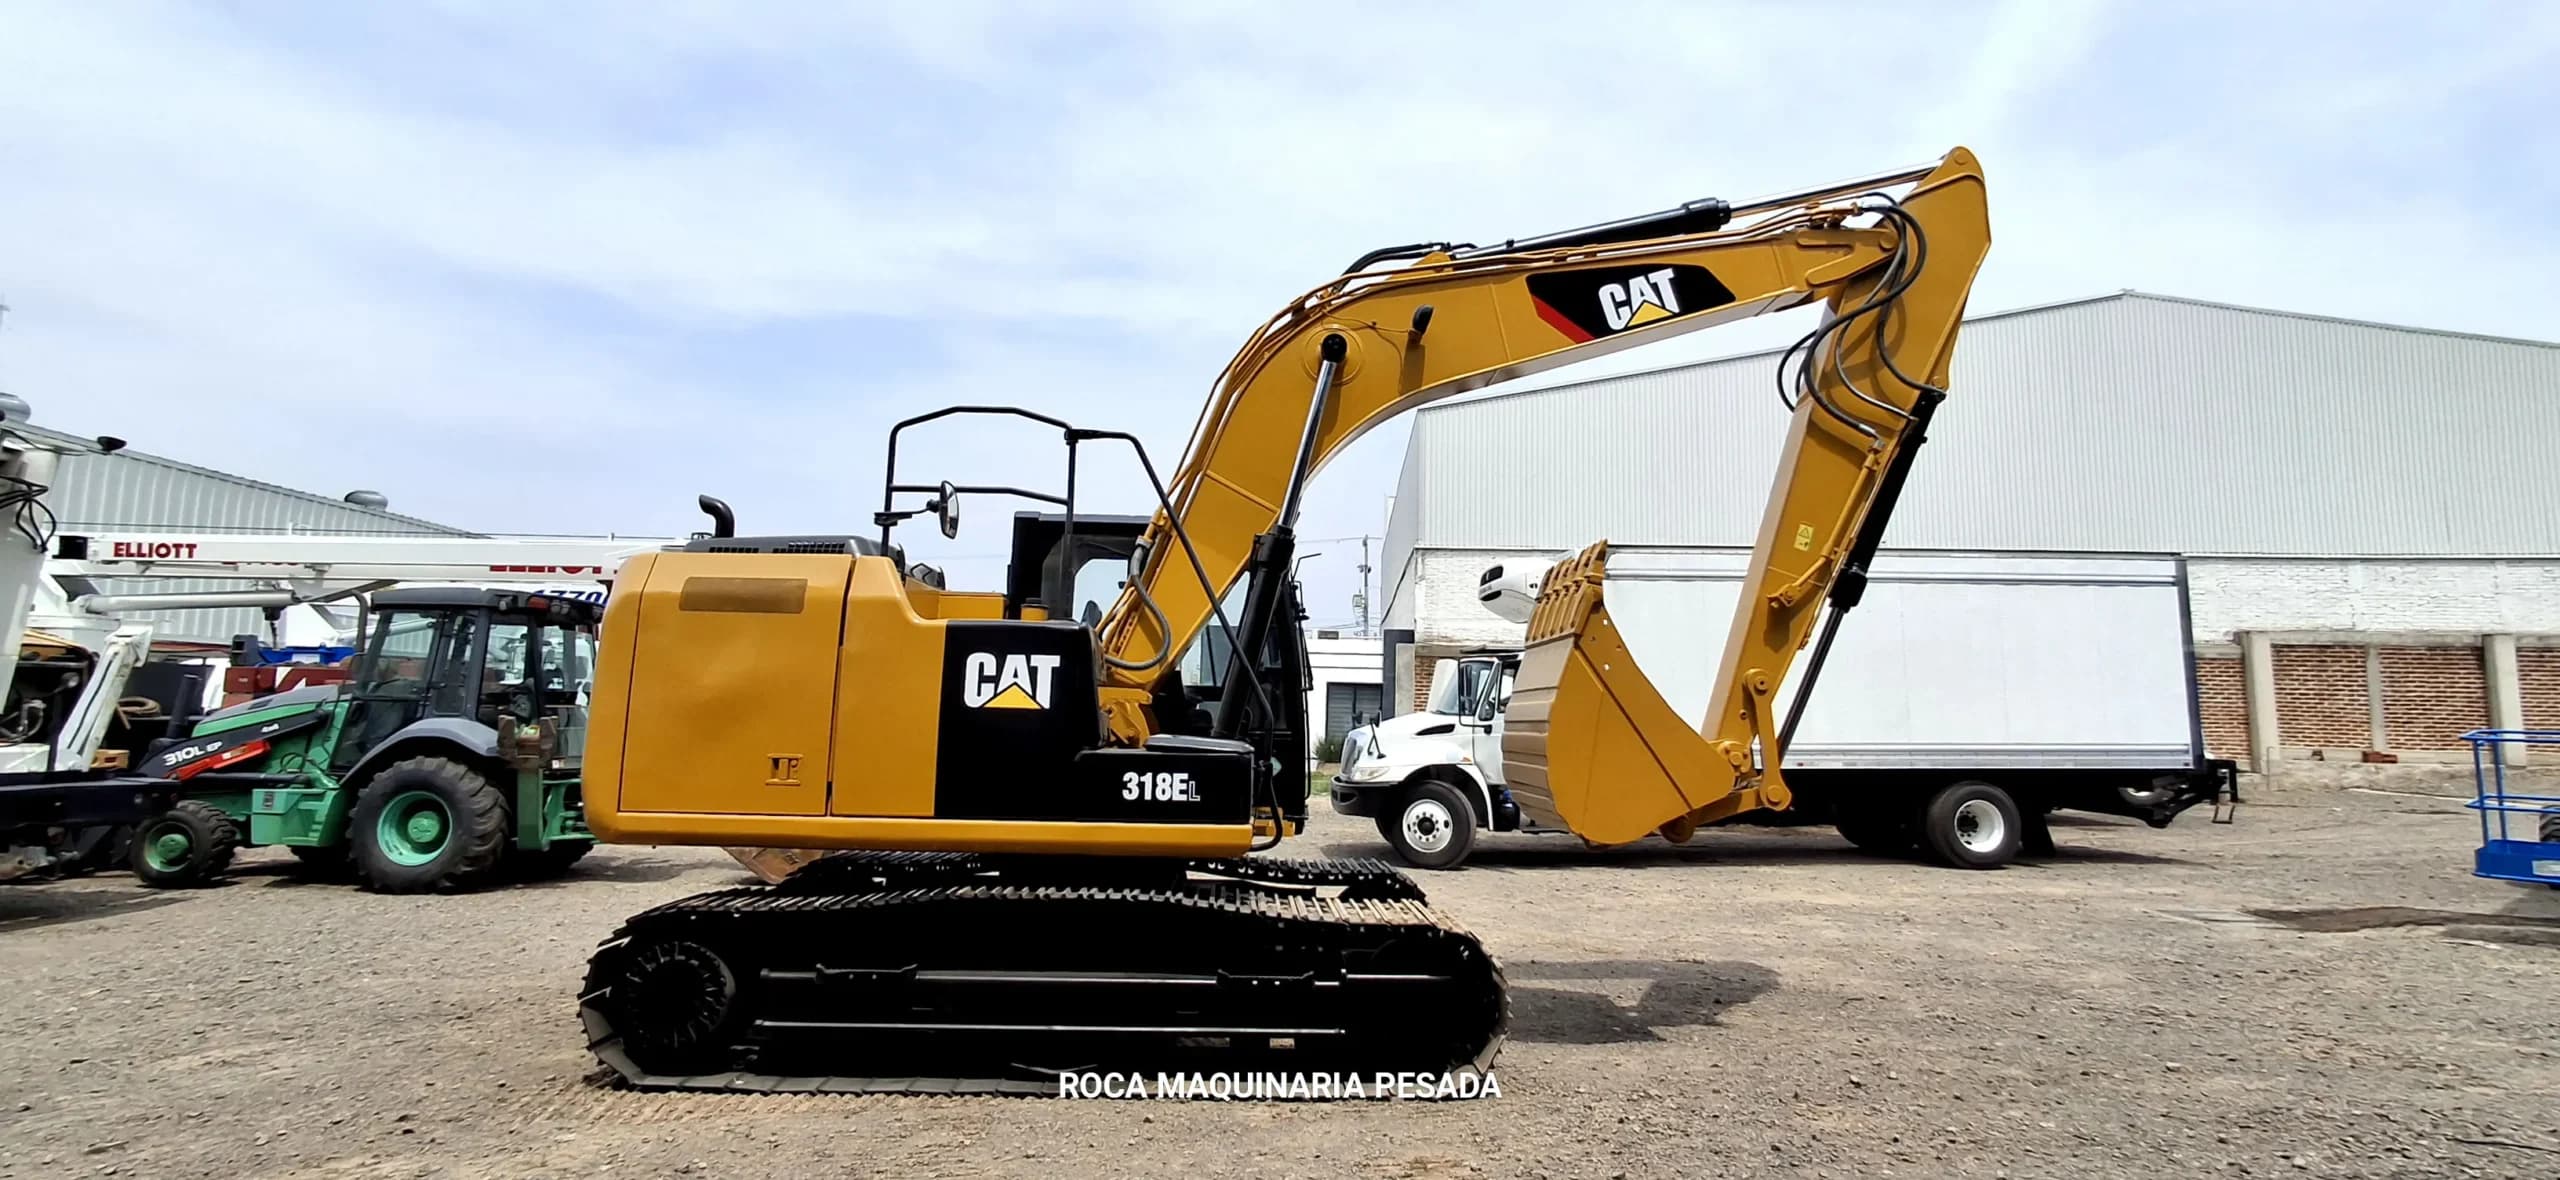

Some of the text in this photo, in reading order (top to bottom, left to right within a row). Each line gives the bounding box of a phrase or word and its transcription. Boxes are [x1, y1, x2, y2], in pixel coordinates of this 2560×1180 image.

[1598, 267, 1680, 330] CAT
[113, 542, 197, 558] ELLIOTT
[964, 652, 1061, 709] CAT
[162, 745, 205, 766] 310L
